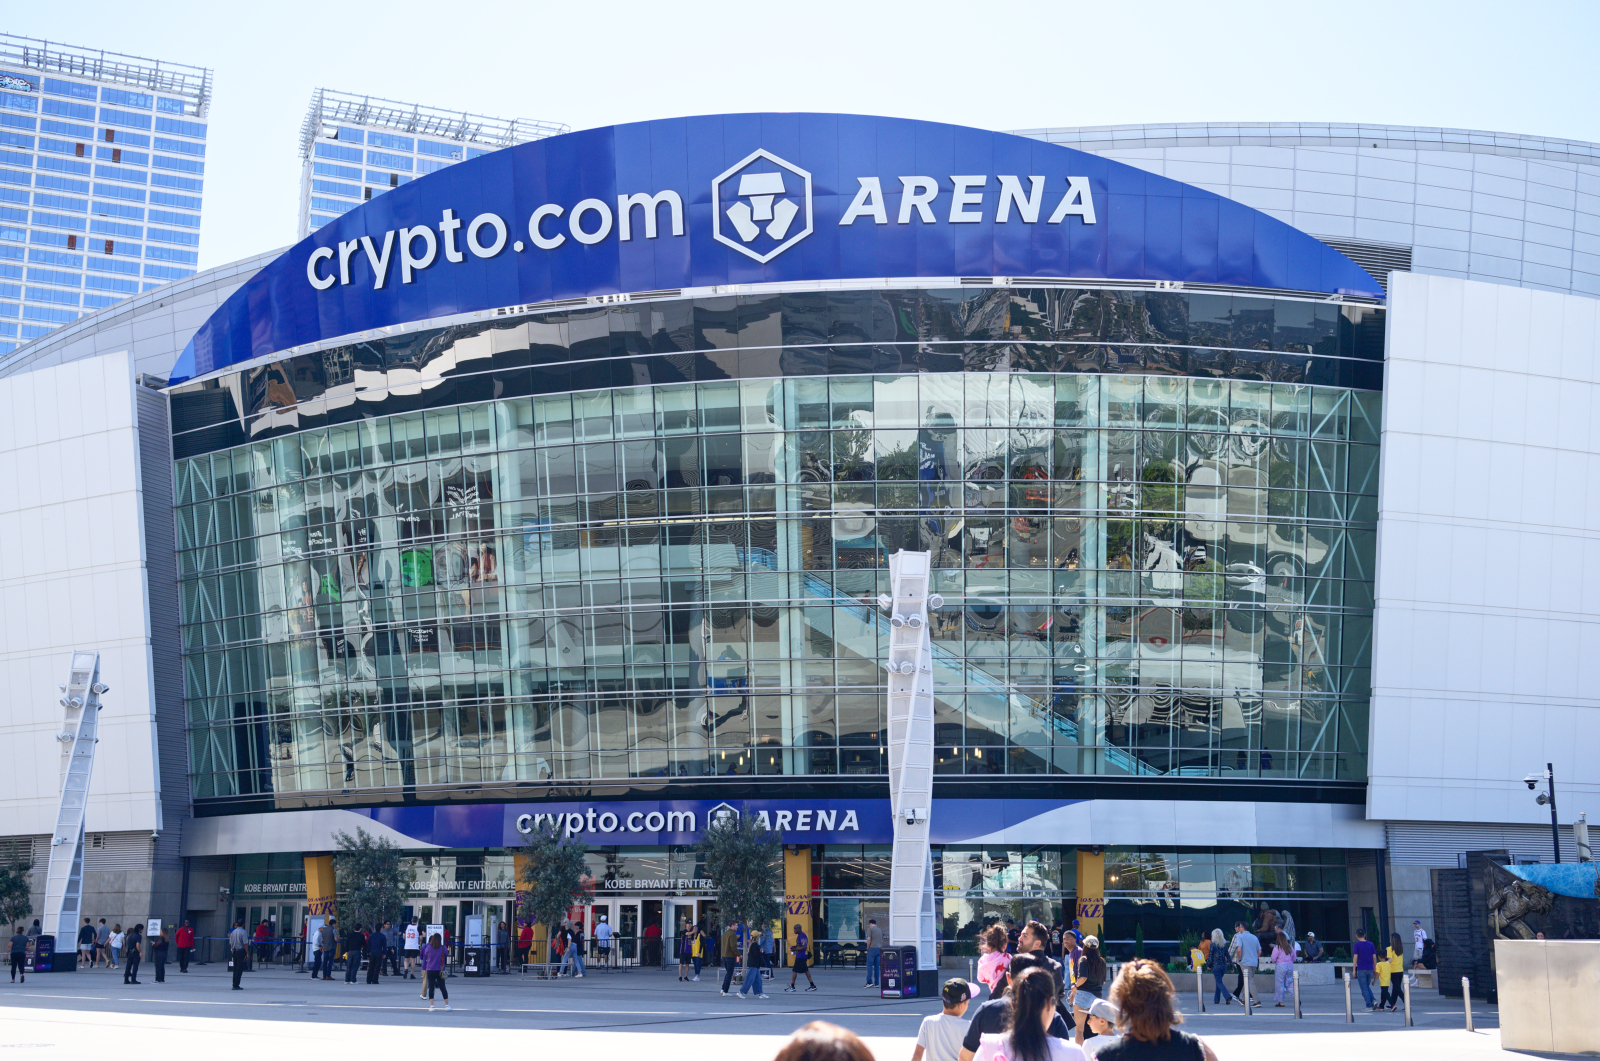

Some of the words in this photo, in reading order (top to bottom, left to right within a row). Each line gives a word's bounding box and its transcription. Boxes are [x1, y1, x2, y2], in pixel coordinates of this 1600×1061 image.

[307, 190, 684, 290] crypto.com
[839, 175, 1097, 225] ARENA
[517, 808, 696, 838] crypto.com
[753, 810, 860, 831] ARENA
[244, 883, 262, 893] KOBE
[262, 883, 289, 893] BRYANT
[289, 883, 307, 892] ENTR
[409, 881, 431, 891] KOBE
[434, 880, 466, 890] BRYANT
[468, 880, 516, 890] ENTRANCE
[604, 879, 632, 889] KOBE
[634, 879, 675, 889] BRYANT
[678, 878, 714, 888] ENTRA
[307, 899, 338, 917] KERS
